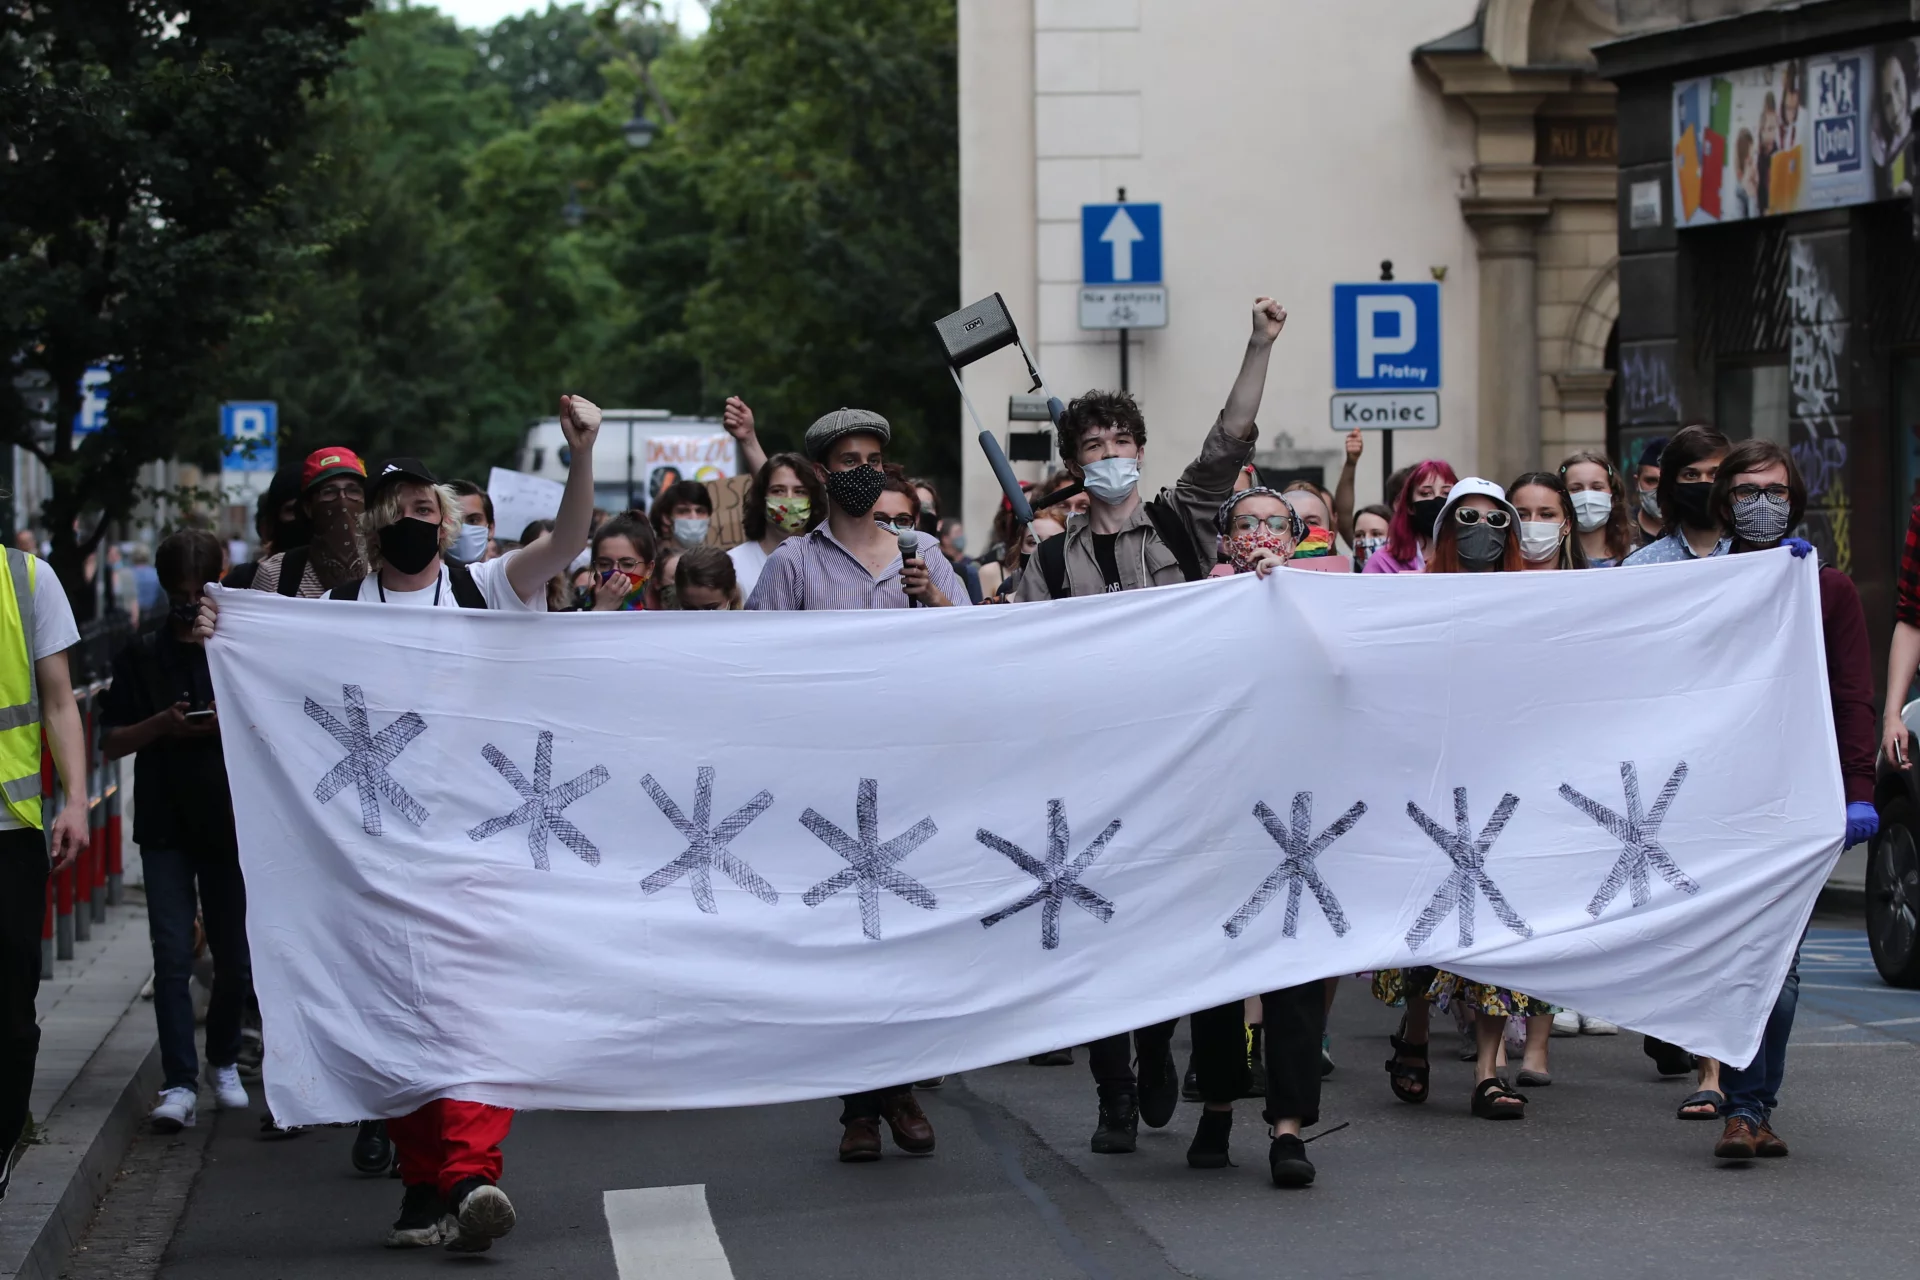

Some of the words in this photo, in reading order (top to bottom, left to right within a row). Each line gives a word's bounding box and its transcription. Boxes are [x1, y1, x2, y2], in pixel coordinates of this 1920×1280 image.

[964, 319, 981, 332] LDM
[1356, 295, 1417, 379] P
[1378, 363, 1428, 382] Płatny
[1343, 401, 1426, 423] Koniec
